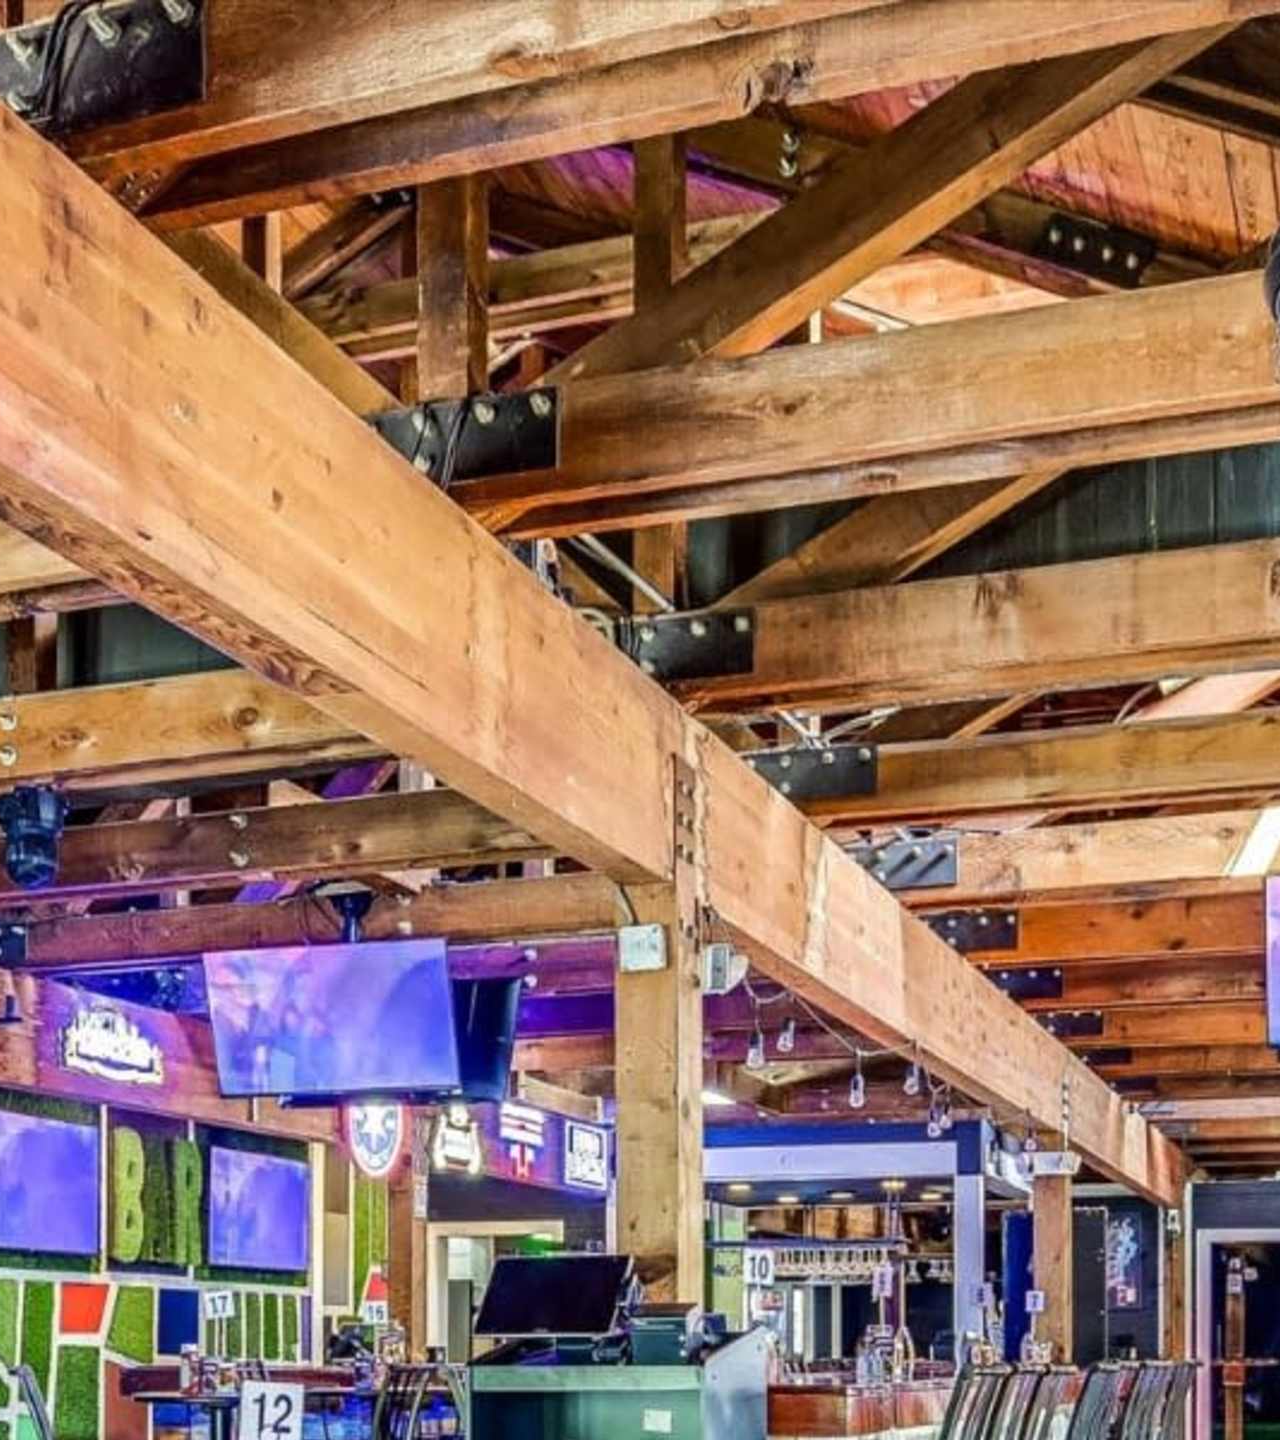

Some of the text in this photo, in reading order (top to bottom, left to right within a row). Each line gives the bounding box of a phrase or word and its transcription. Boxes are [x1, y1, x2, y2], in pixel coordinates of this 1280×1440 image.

[750, 1254, 770, 1279] 10
[209, 1295, 229, 1315] 17
[253, 1392, 293, 1435] 12
